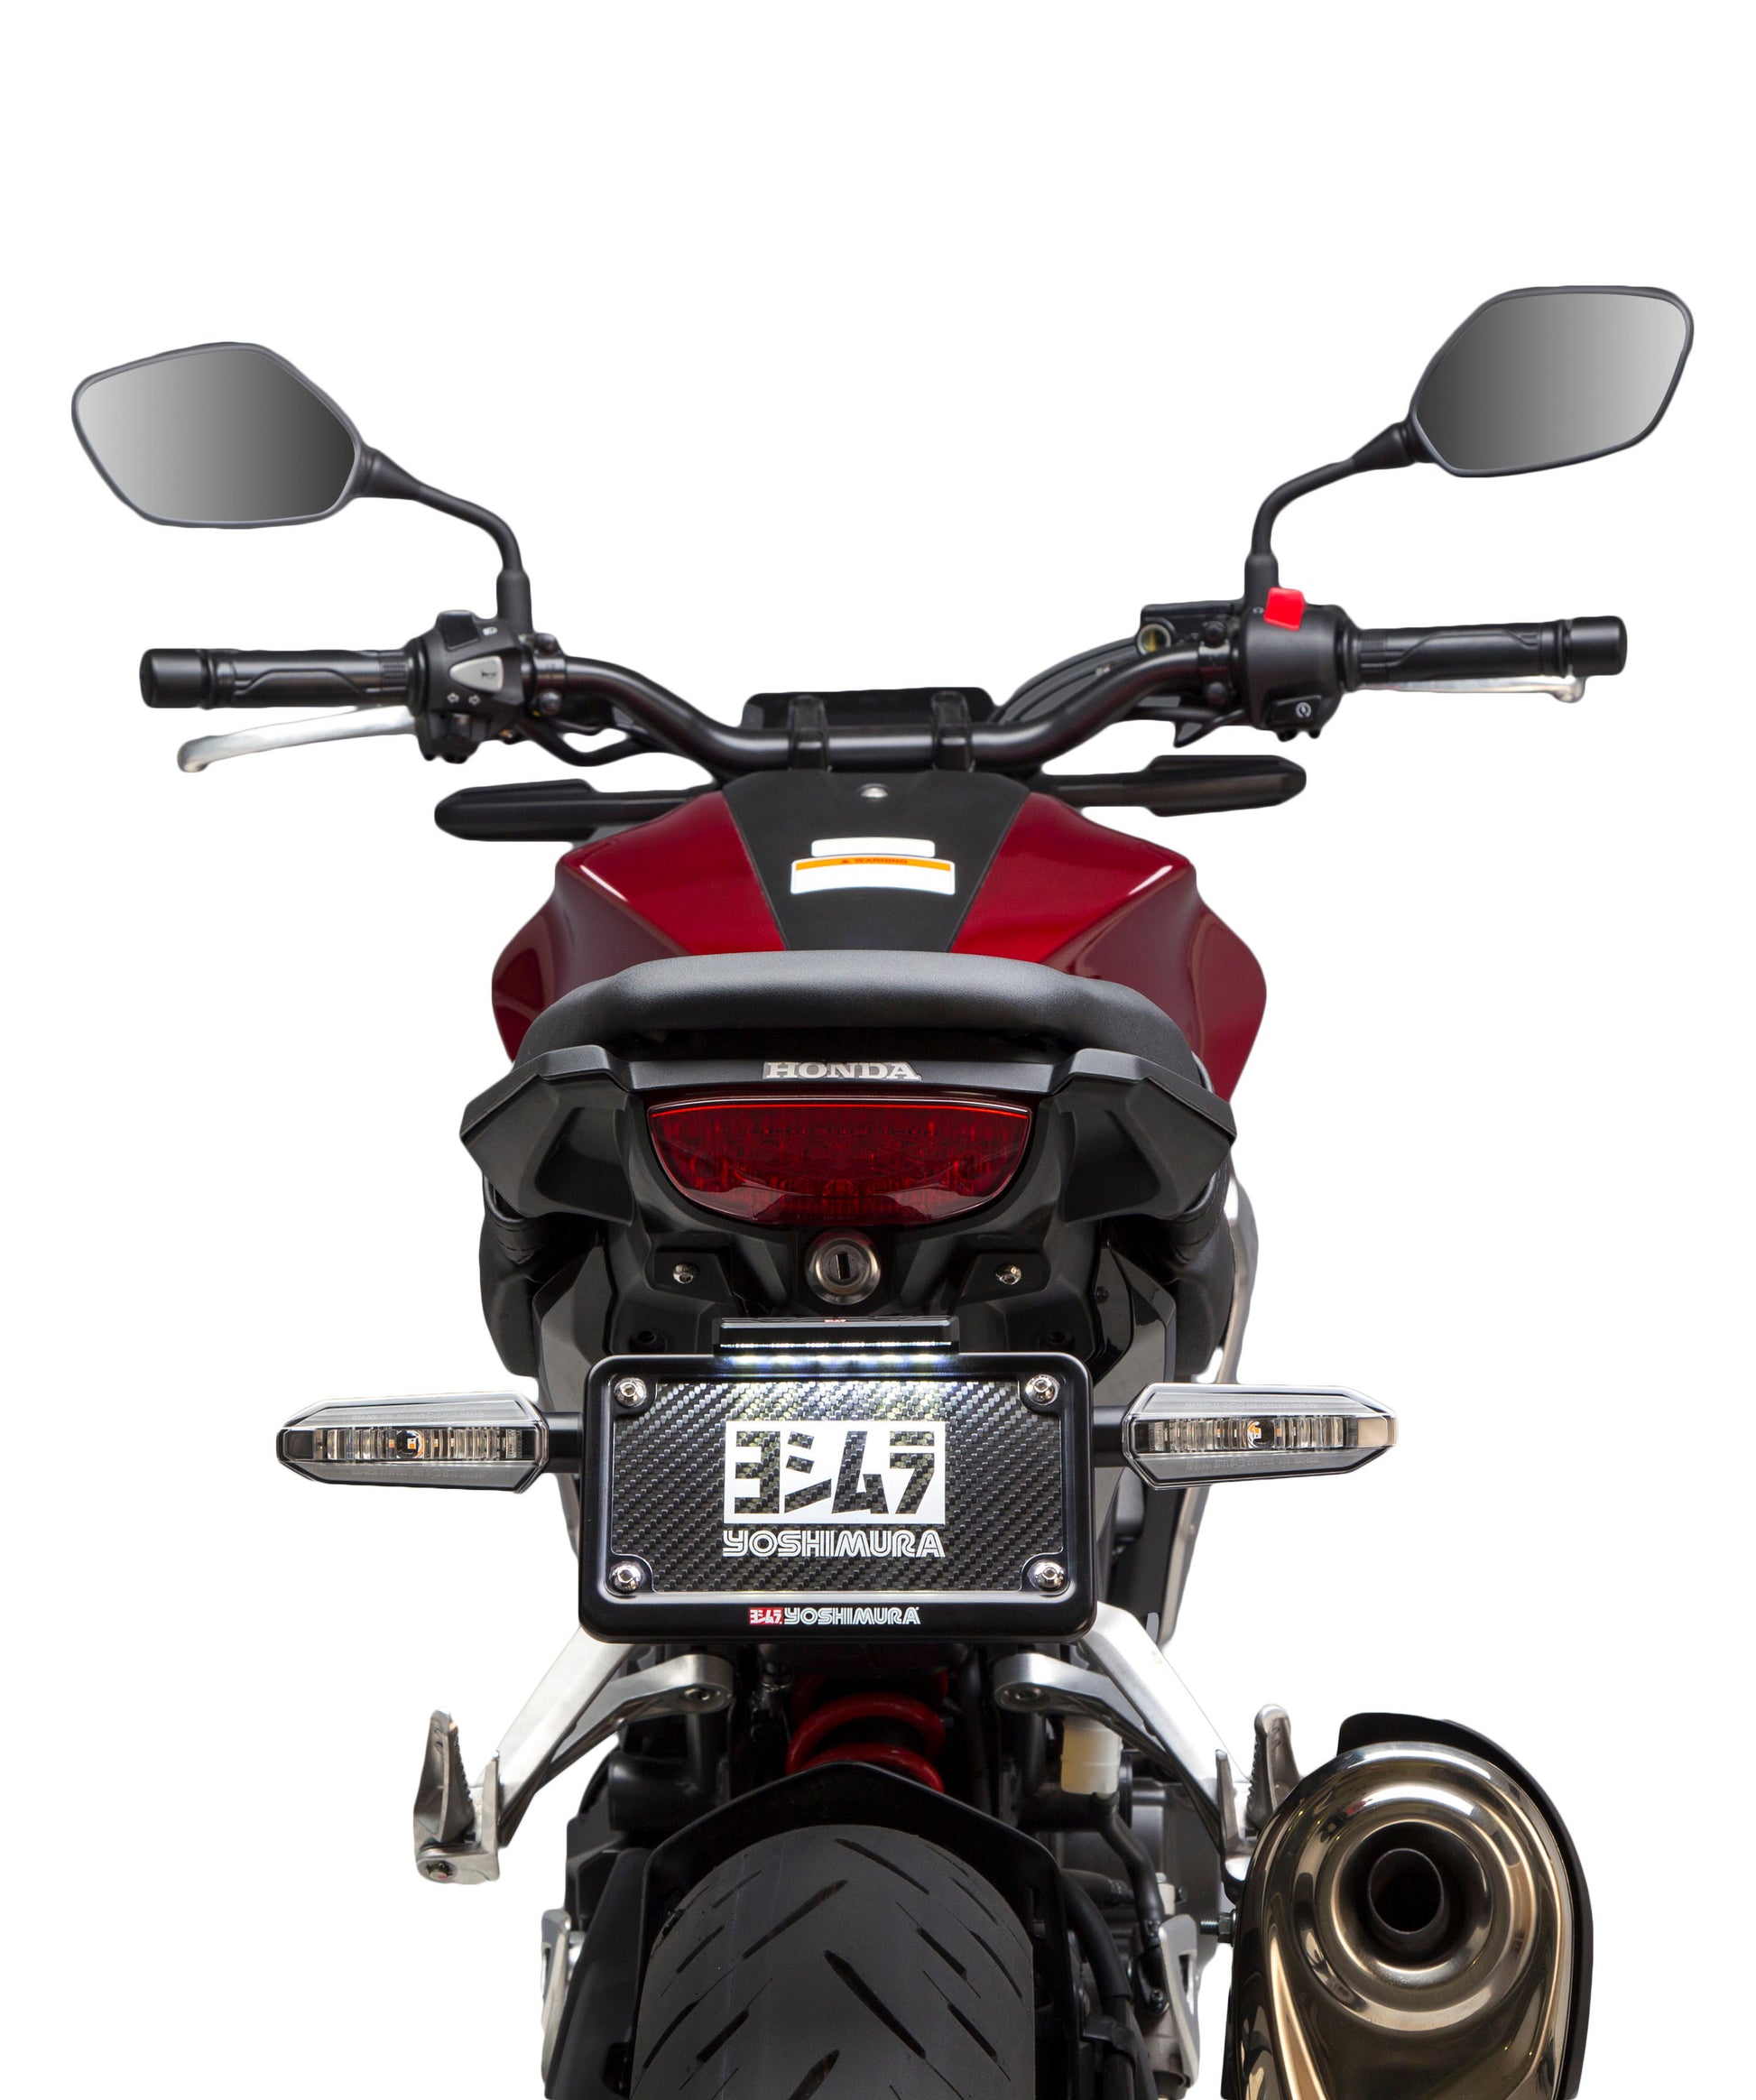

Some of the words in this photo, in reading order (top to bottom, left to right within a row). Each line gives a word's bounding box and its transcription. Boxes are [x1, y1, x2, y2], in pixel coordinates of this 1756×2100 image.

[854, 856, 908, 865] WARNING
[766, 1061, 919, 1079] HONDA
[734, 1430, 935, 1514] ヨシムラ
[723, 1530, 946, 1558] YOSHIMURA
[784, 1606, 920, 1624] YOSHIMURA
